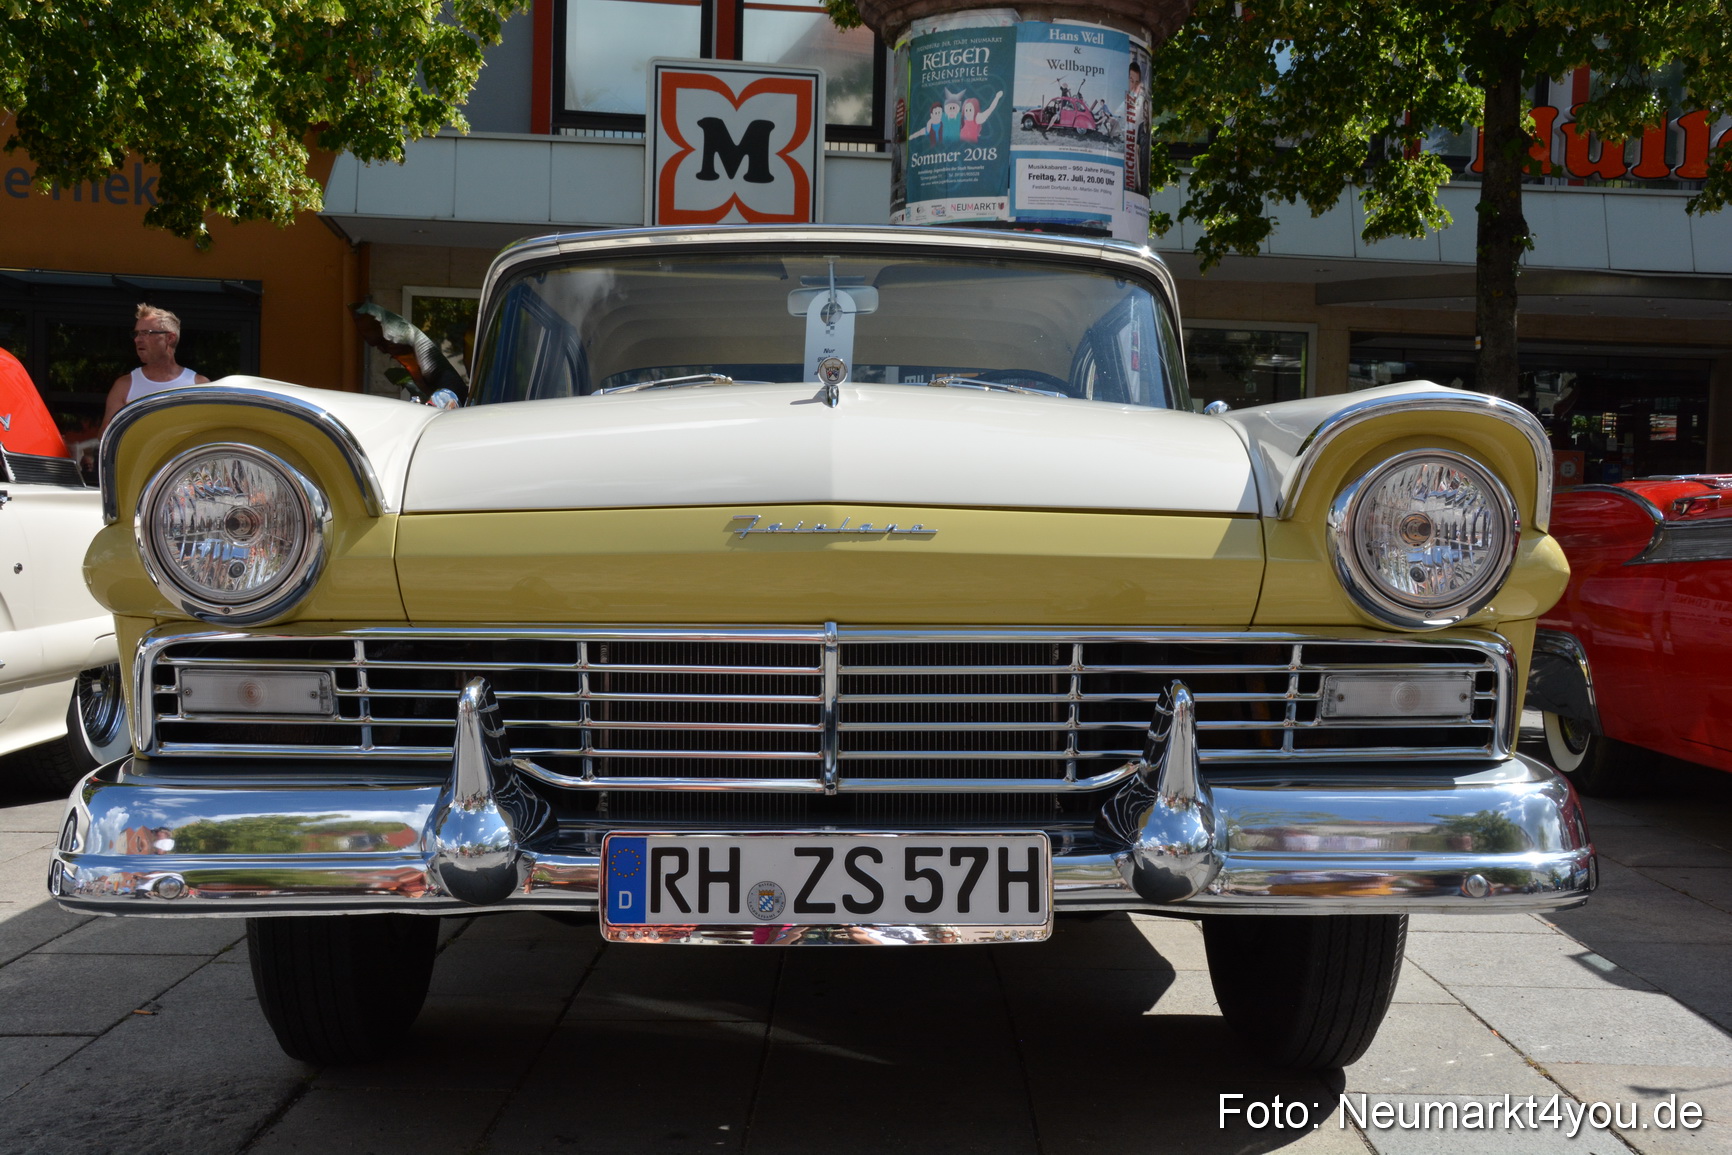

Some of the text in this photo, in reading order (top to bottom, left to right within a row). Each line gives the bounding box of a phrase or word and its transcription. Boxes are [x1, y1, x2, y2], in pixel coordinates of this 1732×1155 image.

[1049, 28, 1104, 45] Hans Well
[921, 46, 991, 71] KELTEN
[1074, 46, 1081, 54] &
[921, 66, 989, 84] FERIENSPIELE
[1046, 59, 1105, 77] Wellbappn
[1125, 93, 1136, 189] MICHAEL FITZ
[696, 117, 775, 184] M
[911, 147, 998, 168] Sommer 2018
[1028, 173, 1115, 186] Freitag, 27. Juli, 20.00 Uhr
[951, 202, 997, 212] NEUMARKT
[732, 515, 938, 539] Fairlane
[650, 846, 1040, 914] RH ZS 57H
[618, 891, 632, 909] D
